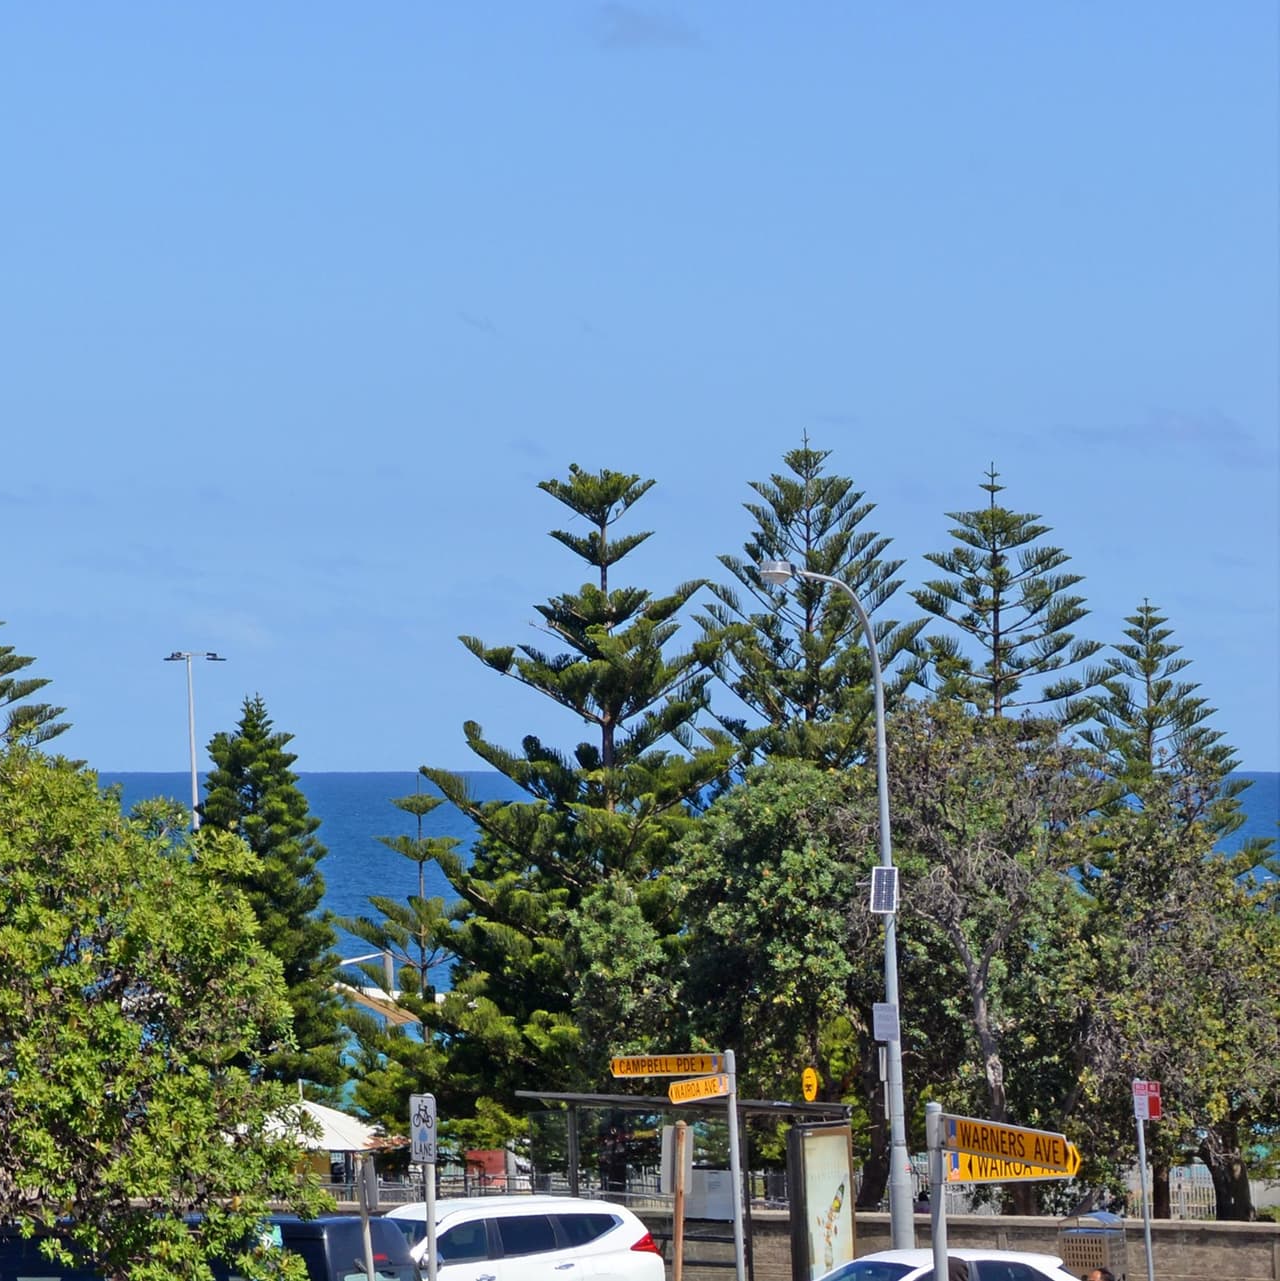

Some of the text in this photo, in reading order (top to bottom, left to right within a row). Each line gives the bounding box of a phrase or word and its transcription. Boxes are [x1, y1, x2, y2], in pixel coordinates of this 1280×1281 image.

[619, 1056, 697, 1074] CAMPBELL PDE
[673, 1079, 717, 1100] WAIROA AVE
[414, 1141, 433, 1157] LANE
[960, 1122, 1060, 1164] WARNERS AVE
